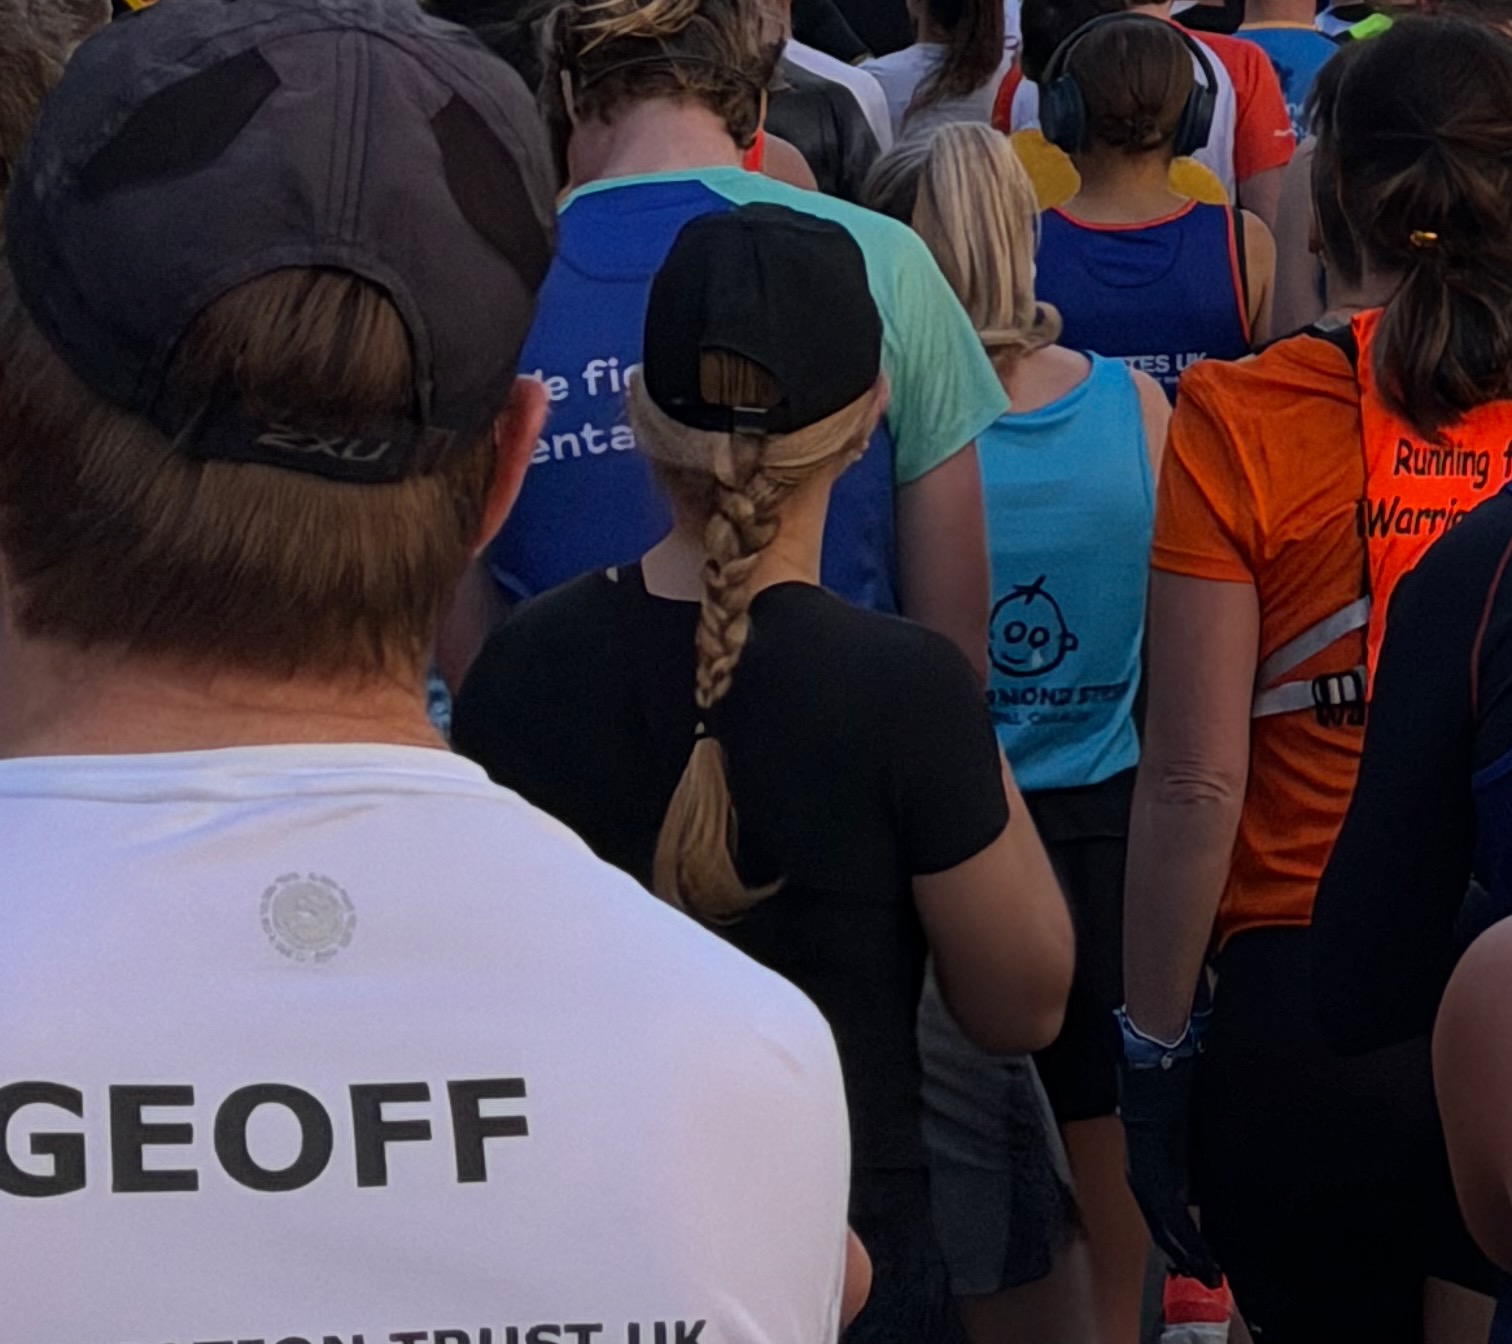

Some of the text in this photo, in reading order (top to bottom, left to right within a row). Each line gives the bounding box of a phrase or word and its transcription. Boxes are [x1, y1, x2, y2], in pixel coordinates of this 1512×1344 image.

[530, 422, 637, 464] enta
[1393, 438, 1491, 490] Running
[0, 1077, 529, 1198] GEOFF
